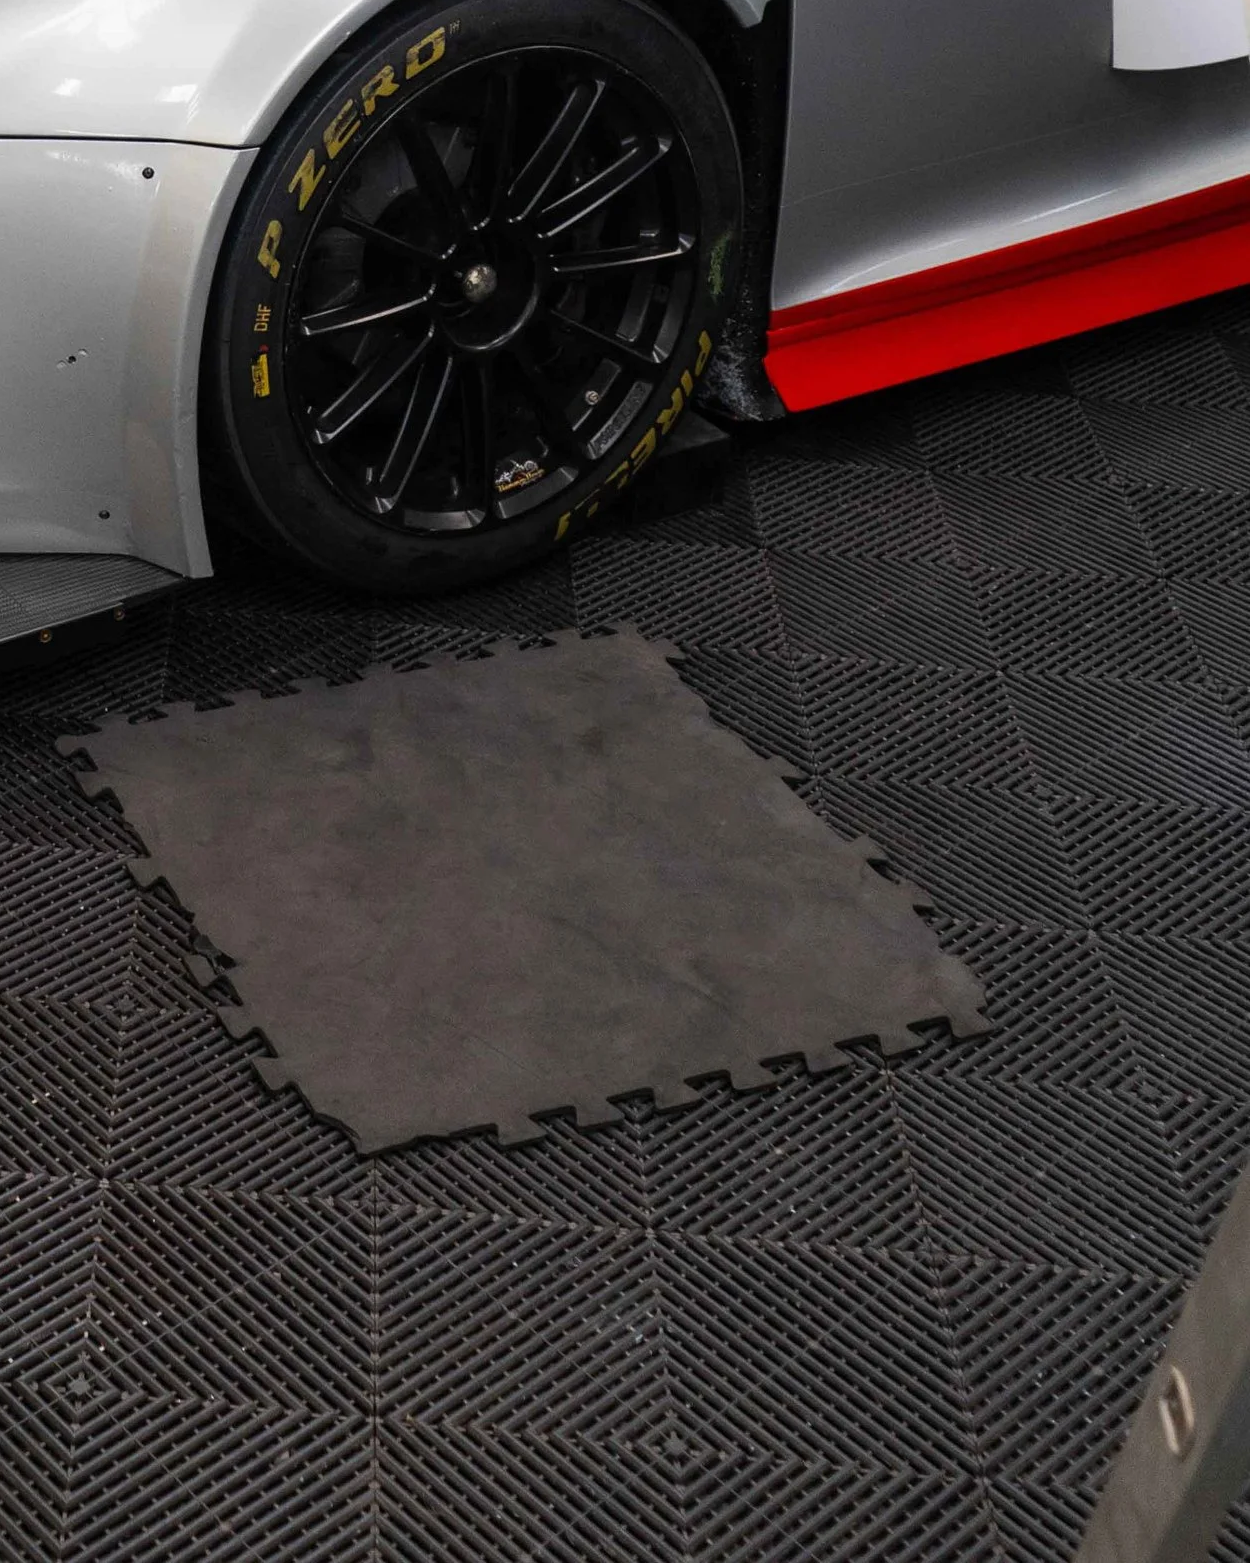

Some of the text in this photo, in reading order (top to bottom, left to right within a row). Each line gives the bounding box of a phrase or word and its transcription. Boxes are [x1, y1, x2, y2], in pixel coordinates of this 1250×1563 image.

[257, 219, 283, 279] P
[288, 26, 446, 212] ZERO
[253, 303, 271, 332] DHF
